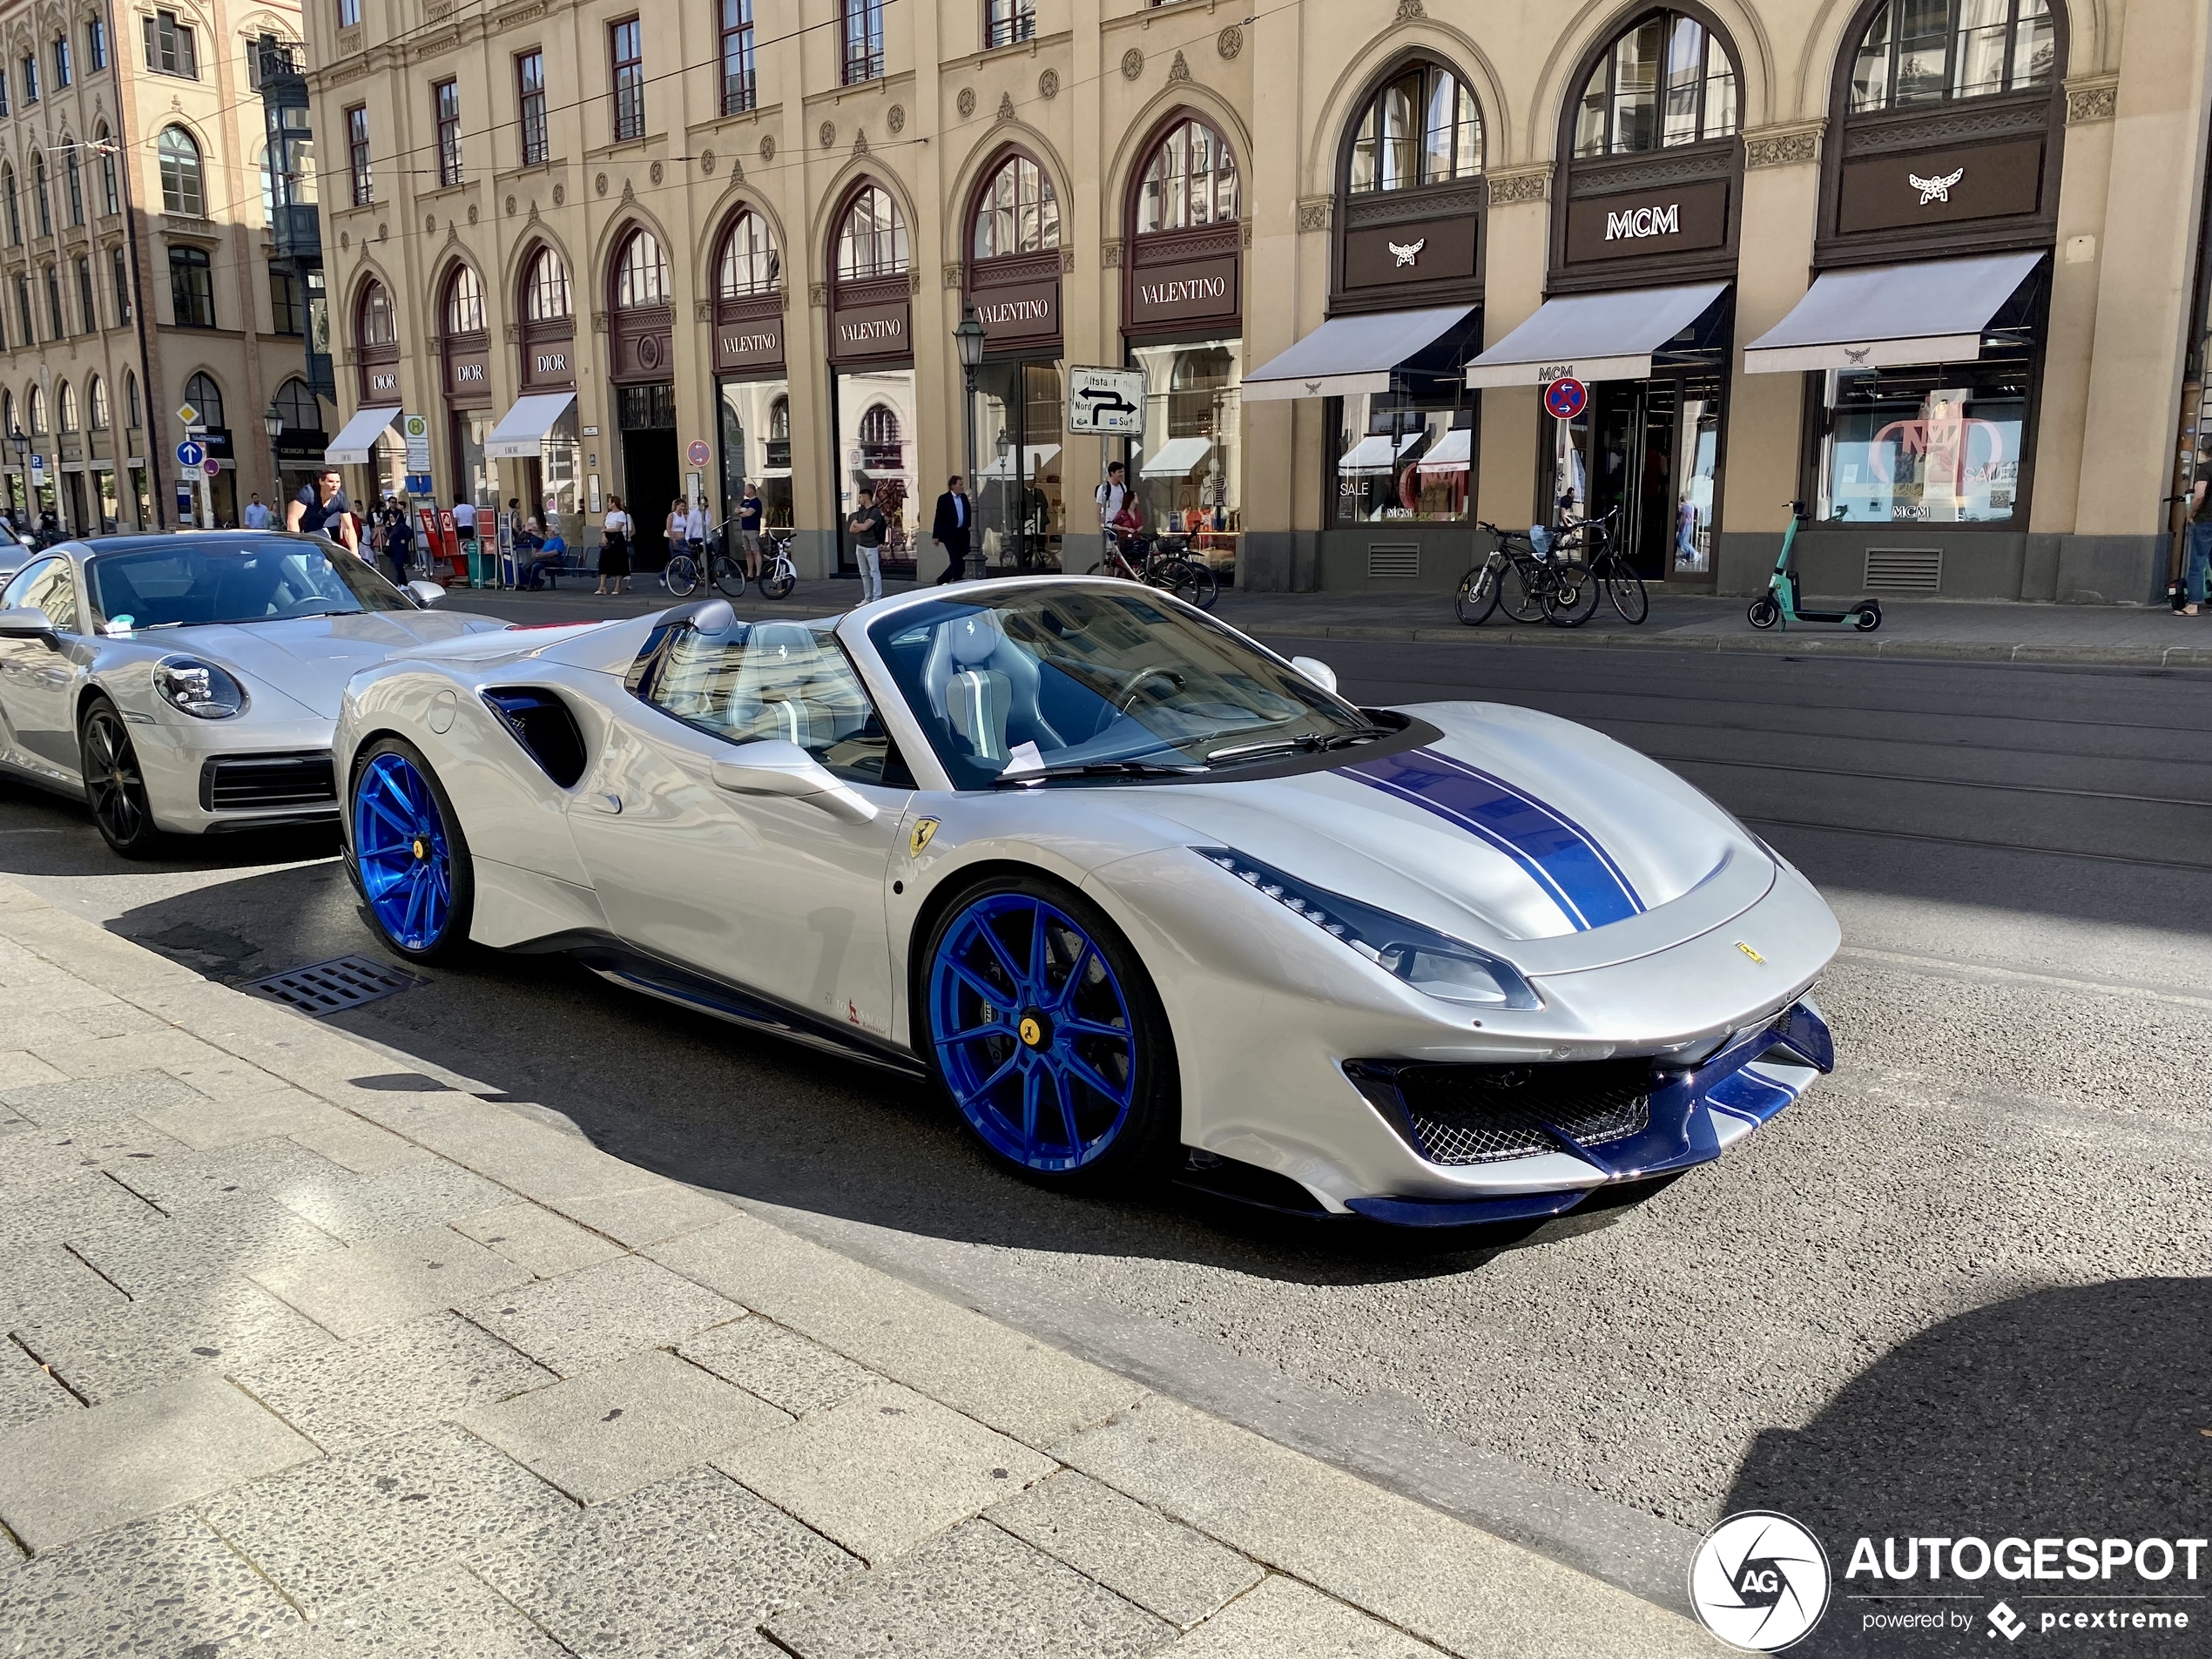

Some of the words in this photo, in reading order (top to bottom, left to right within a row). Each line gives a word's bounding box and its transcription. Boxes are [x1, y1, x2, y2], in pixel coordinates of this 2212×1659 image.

[1604, 204, 1680, 240] MCM
[1141, 276, 1225, 305] VALENTINO
[977, 299, 1049, 324] VALENTINO
[840, 318, 900, 341] VALENTINO
[723, 333, 776, 354] VALENTINO
[537, 354, 567, 372] DIOR
[457, 364, 484, 381] DIOR
[1538, 365, 1574, 381] MCM
[373, 374, 396, 390] DIOR
[1075, 401, 1092, 411] Nord
[412, 421, 420, 431] H
[504, 446, 518, 455] DIOR
[32, 456, 40, 467] P
[1963, 466, 2011, 482] SALE
[1339, 482, 1369, 496] SALE
[1386, 508, 1413, 519] MCM
[1892, 505, 1931, 518] MCM
[1779, 592, 1788, 609] TIER
